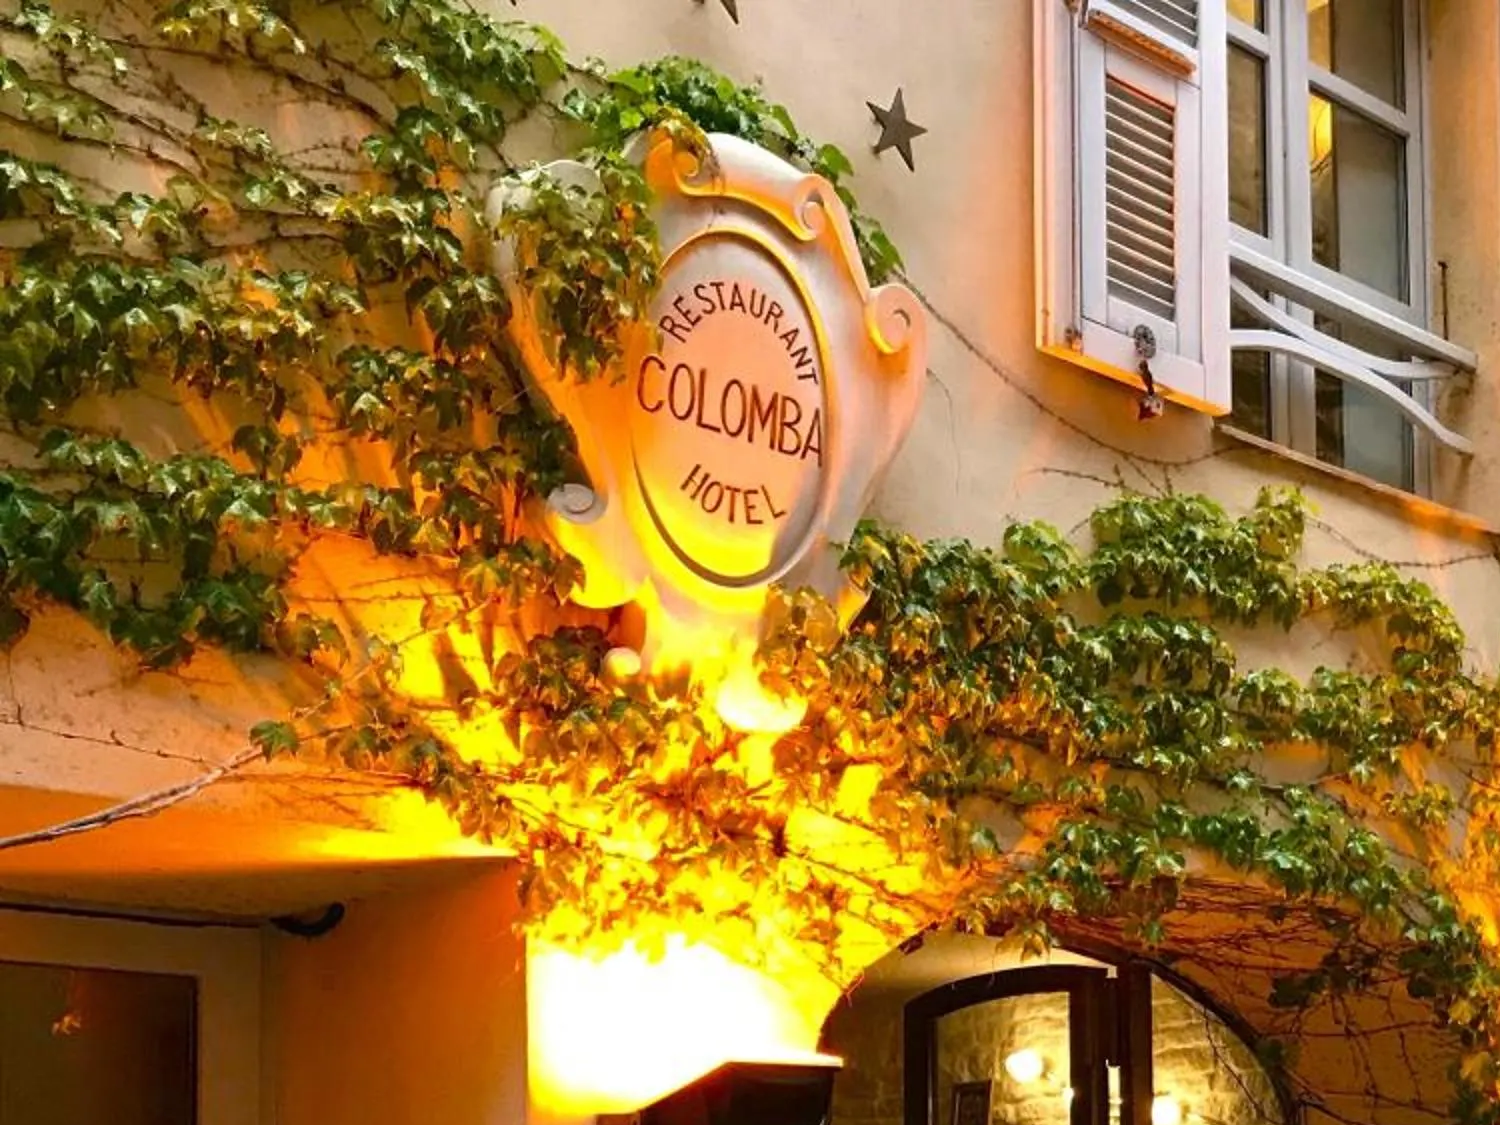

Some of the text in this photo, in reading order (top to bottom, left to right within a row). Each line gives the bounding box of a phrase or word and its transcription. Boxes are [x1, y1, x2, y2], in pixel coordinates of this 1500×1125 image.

[659, 281, 819, 386] RESTAURANT
[637, 355, 823, 468] COLOMBA
[680, 463, 787, 525] HOTEL
